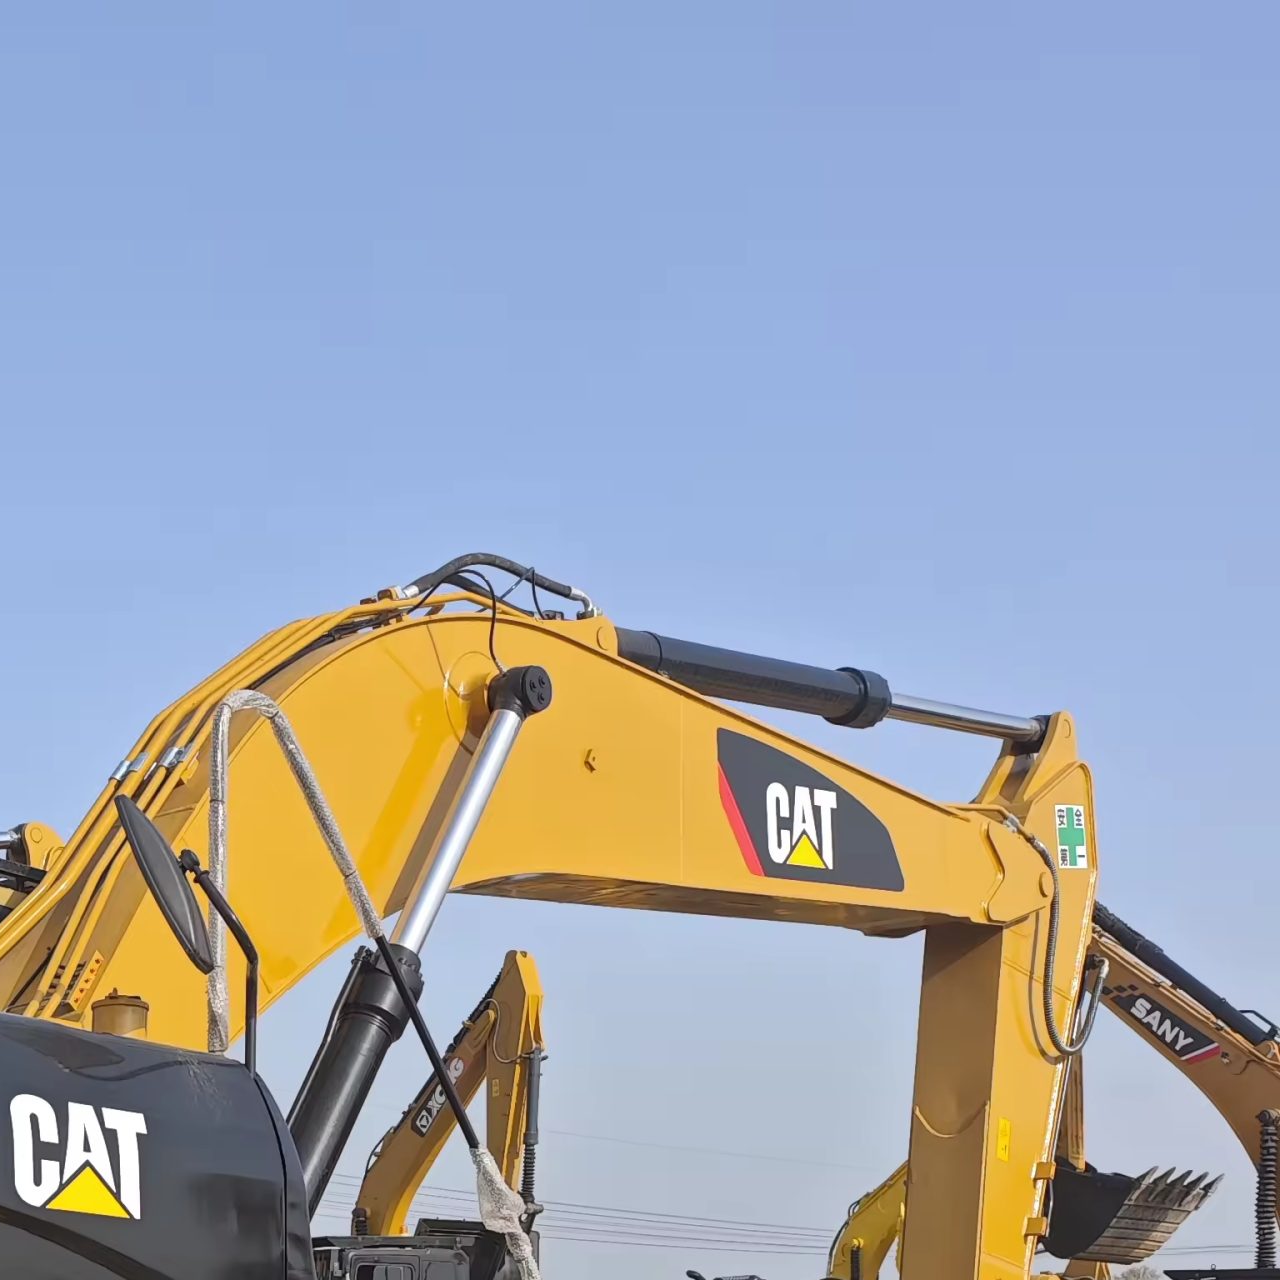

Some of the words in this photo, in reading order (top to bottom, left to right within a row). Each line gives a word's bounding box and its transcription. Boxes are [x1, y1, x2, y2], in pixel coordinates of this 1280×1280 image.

[766, 782, 837, 870] CAT
[1130, 998, 1194, 1051] SANY
[10, 1094, 147, 1219] CAT
